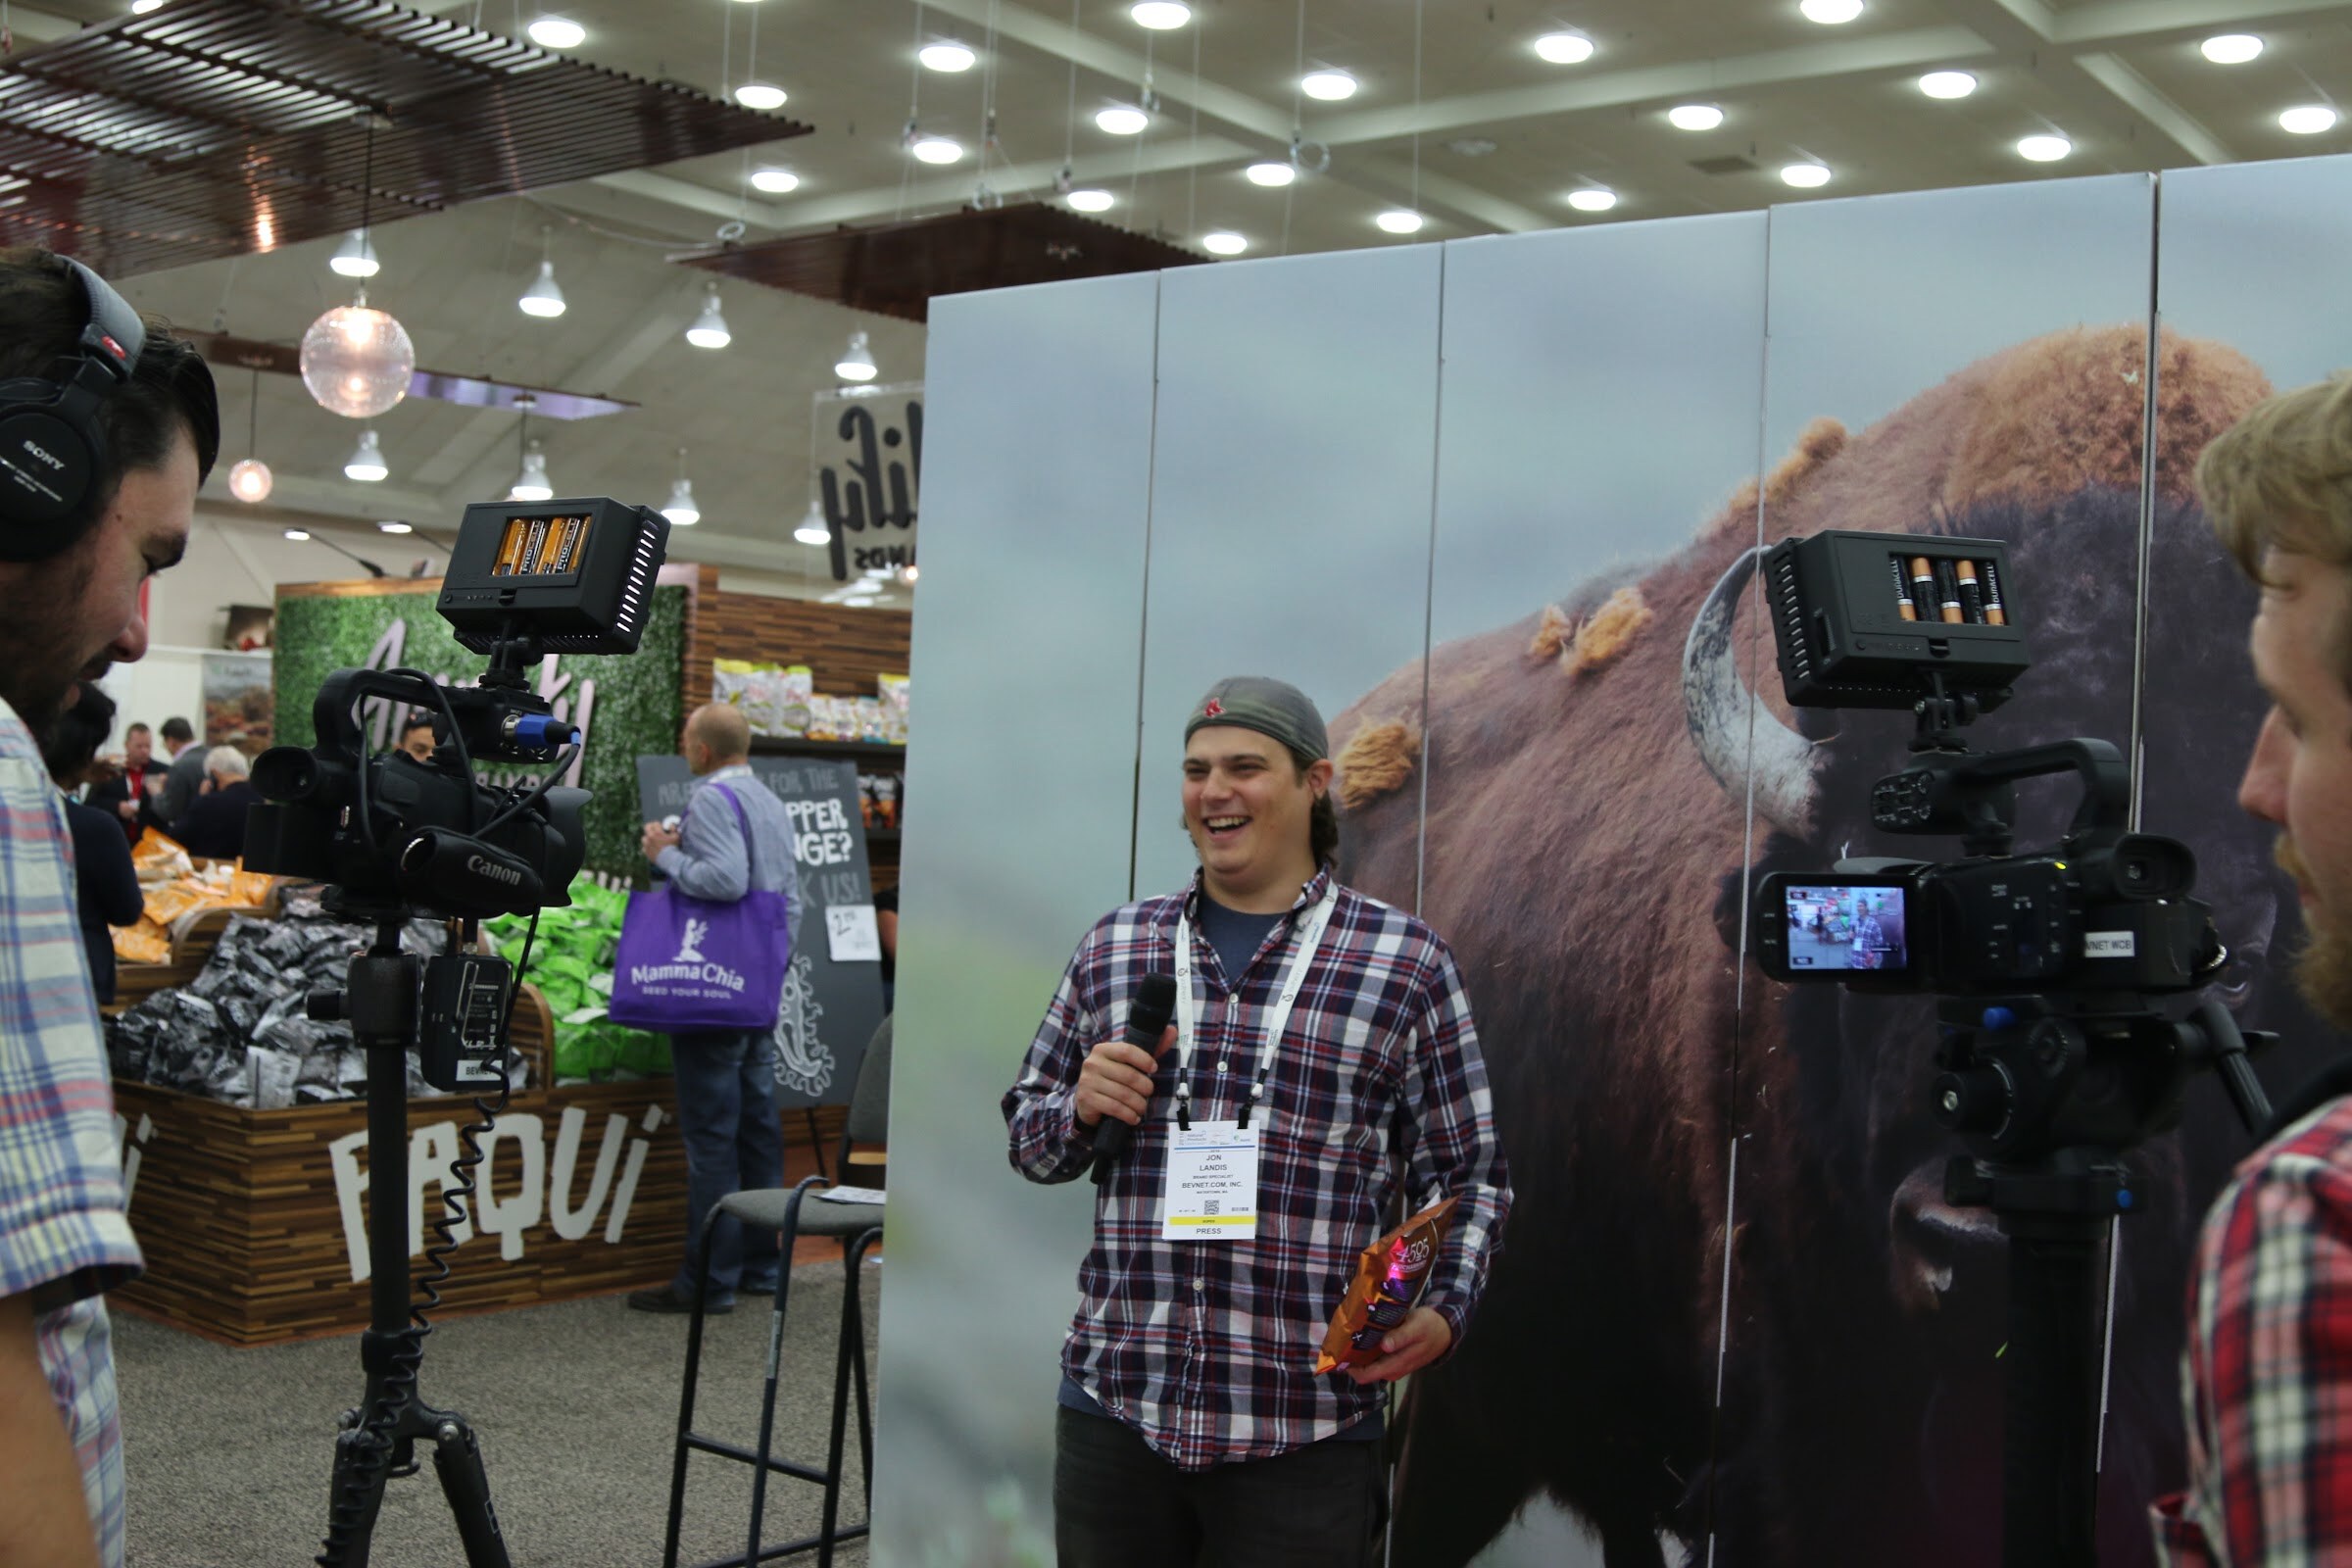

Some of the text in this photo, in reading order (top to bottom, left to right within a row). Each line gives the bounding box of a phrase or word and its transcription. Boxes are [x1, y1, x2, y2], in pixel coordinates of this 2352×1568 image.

[23, 440, 65, 470] SONY
[522, 519, 541, 572] PROCELL
[557, 517, 578, 571] PROCELL
[1889, 559, 1905, 599] DURACELL
[1985, 564, 2000, 603] DURACELL
[769, 770, 806, 794] FOR
[806, 766, 839, 791] THE
[467, 855, 521, 886] Canon
[821, 871, 862, 906] US!
[642, 986, 733, 1000] SEED YOUR SOUL
[1396, 1238, 1430, 1263] 4505
